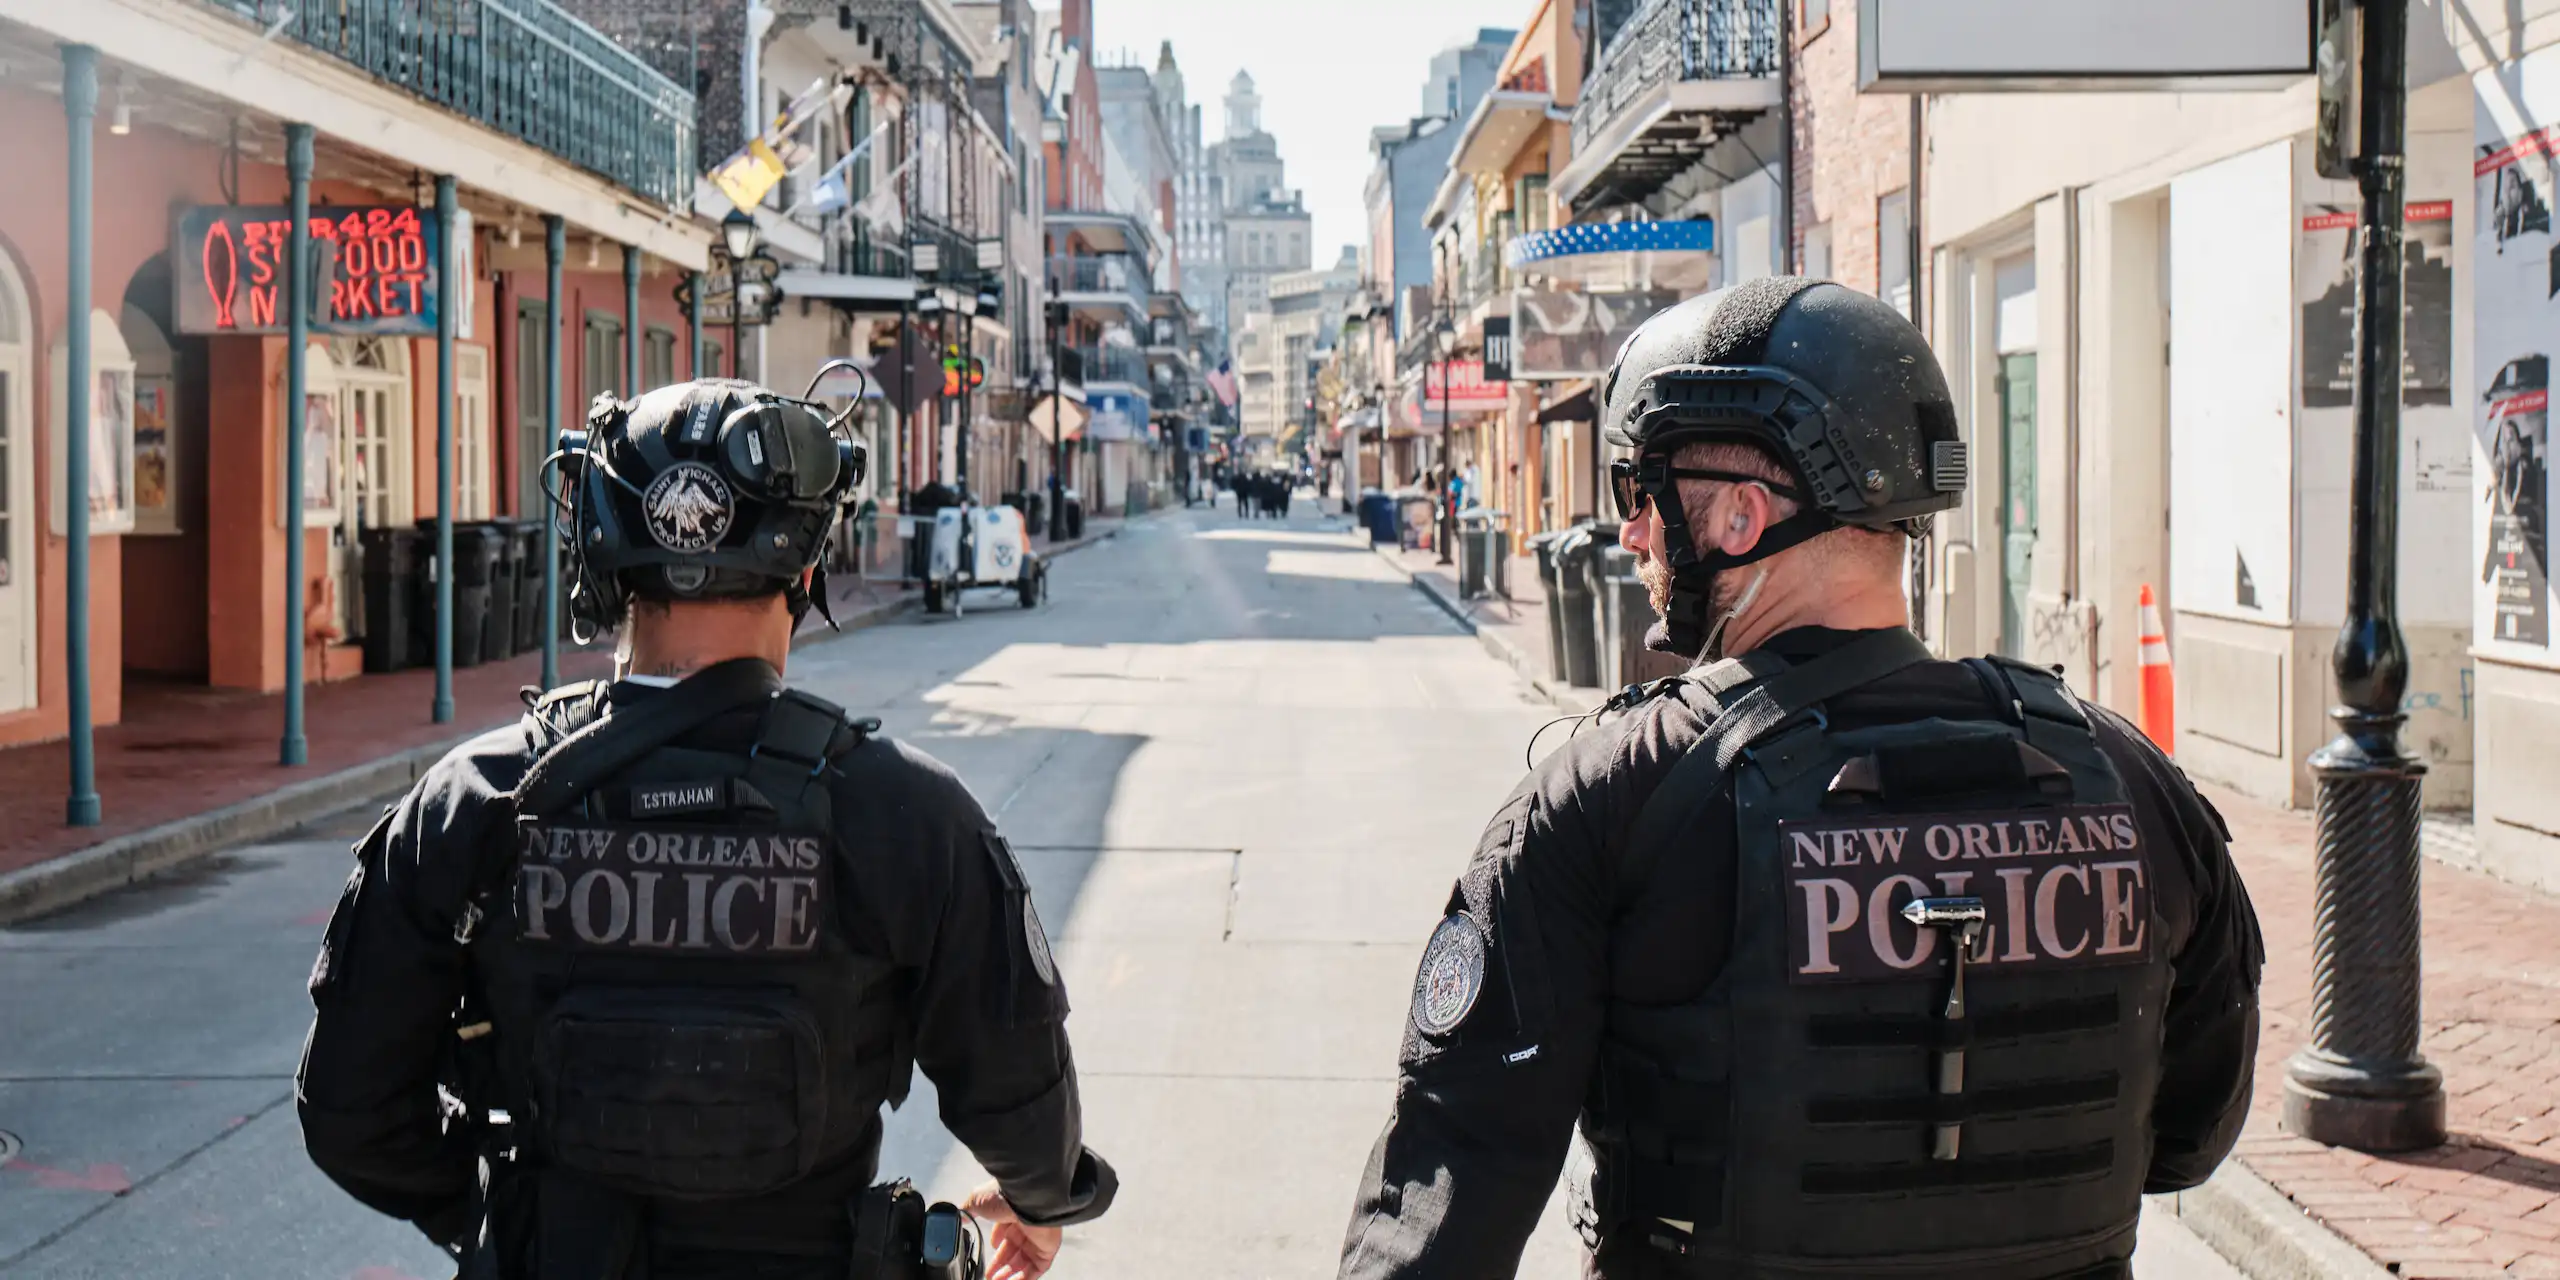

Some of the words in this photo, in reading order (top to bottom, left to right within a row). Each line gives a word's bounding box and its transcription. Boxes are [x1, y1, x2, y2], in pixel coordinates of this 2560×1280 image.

[339, 207, 421, 238] 424
[648, 475, 672, 511] SAINT
[677, 467, 728, 504] MICHAEL
[653, 520, 708, 549] PROTECT
[711, 514, 727, 533] US
[524, 827, 616, 861] NEW
[626, 831, 821, 870] ORLEANS
[1789, 827, 1909, 868] NEW
[1924, 813, 2138, 862] ORLEANS
[521, 863, 819, 952] POLICE
